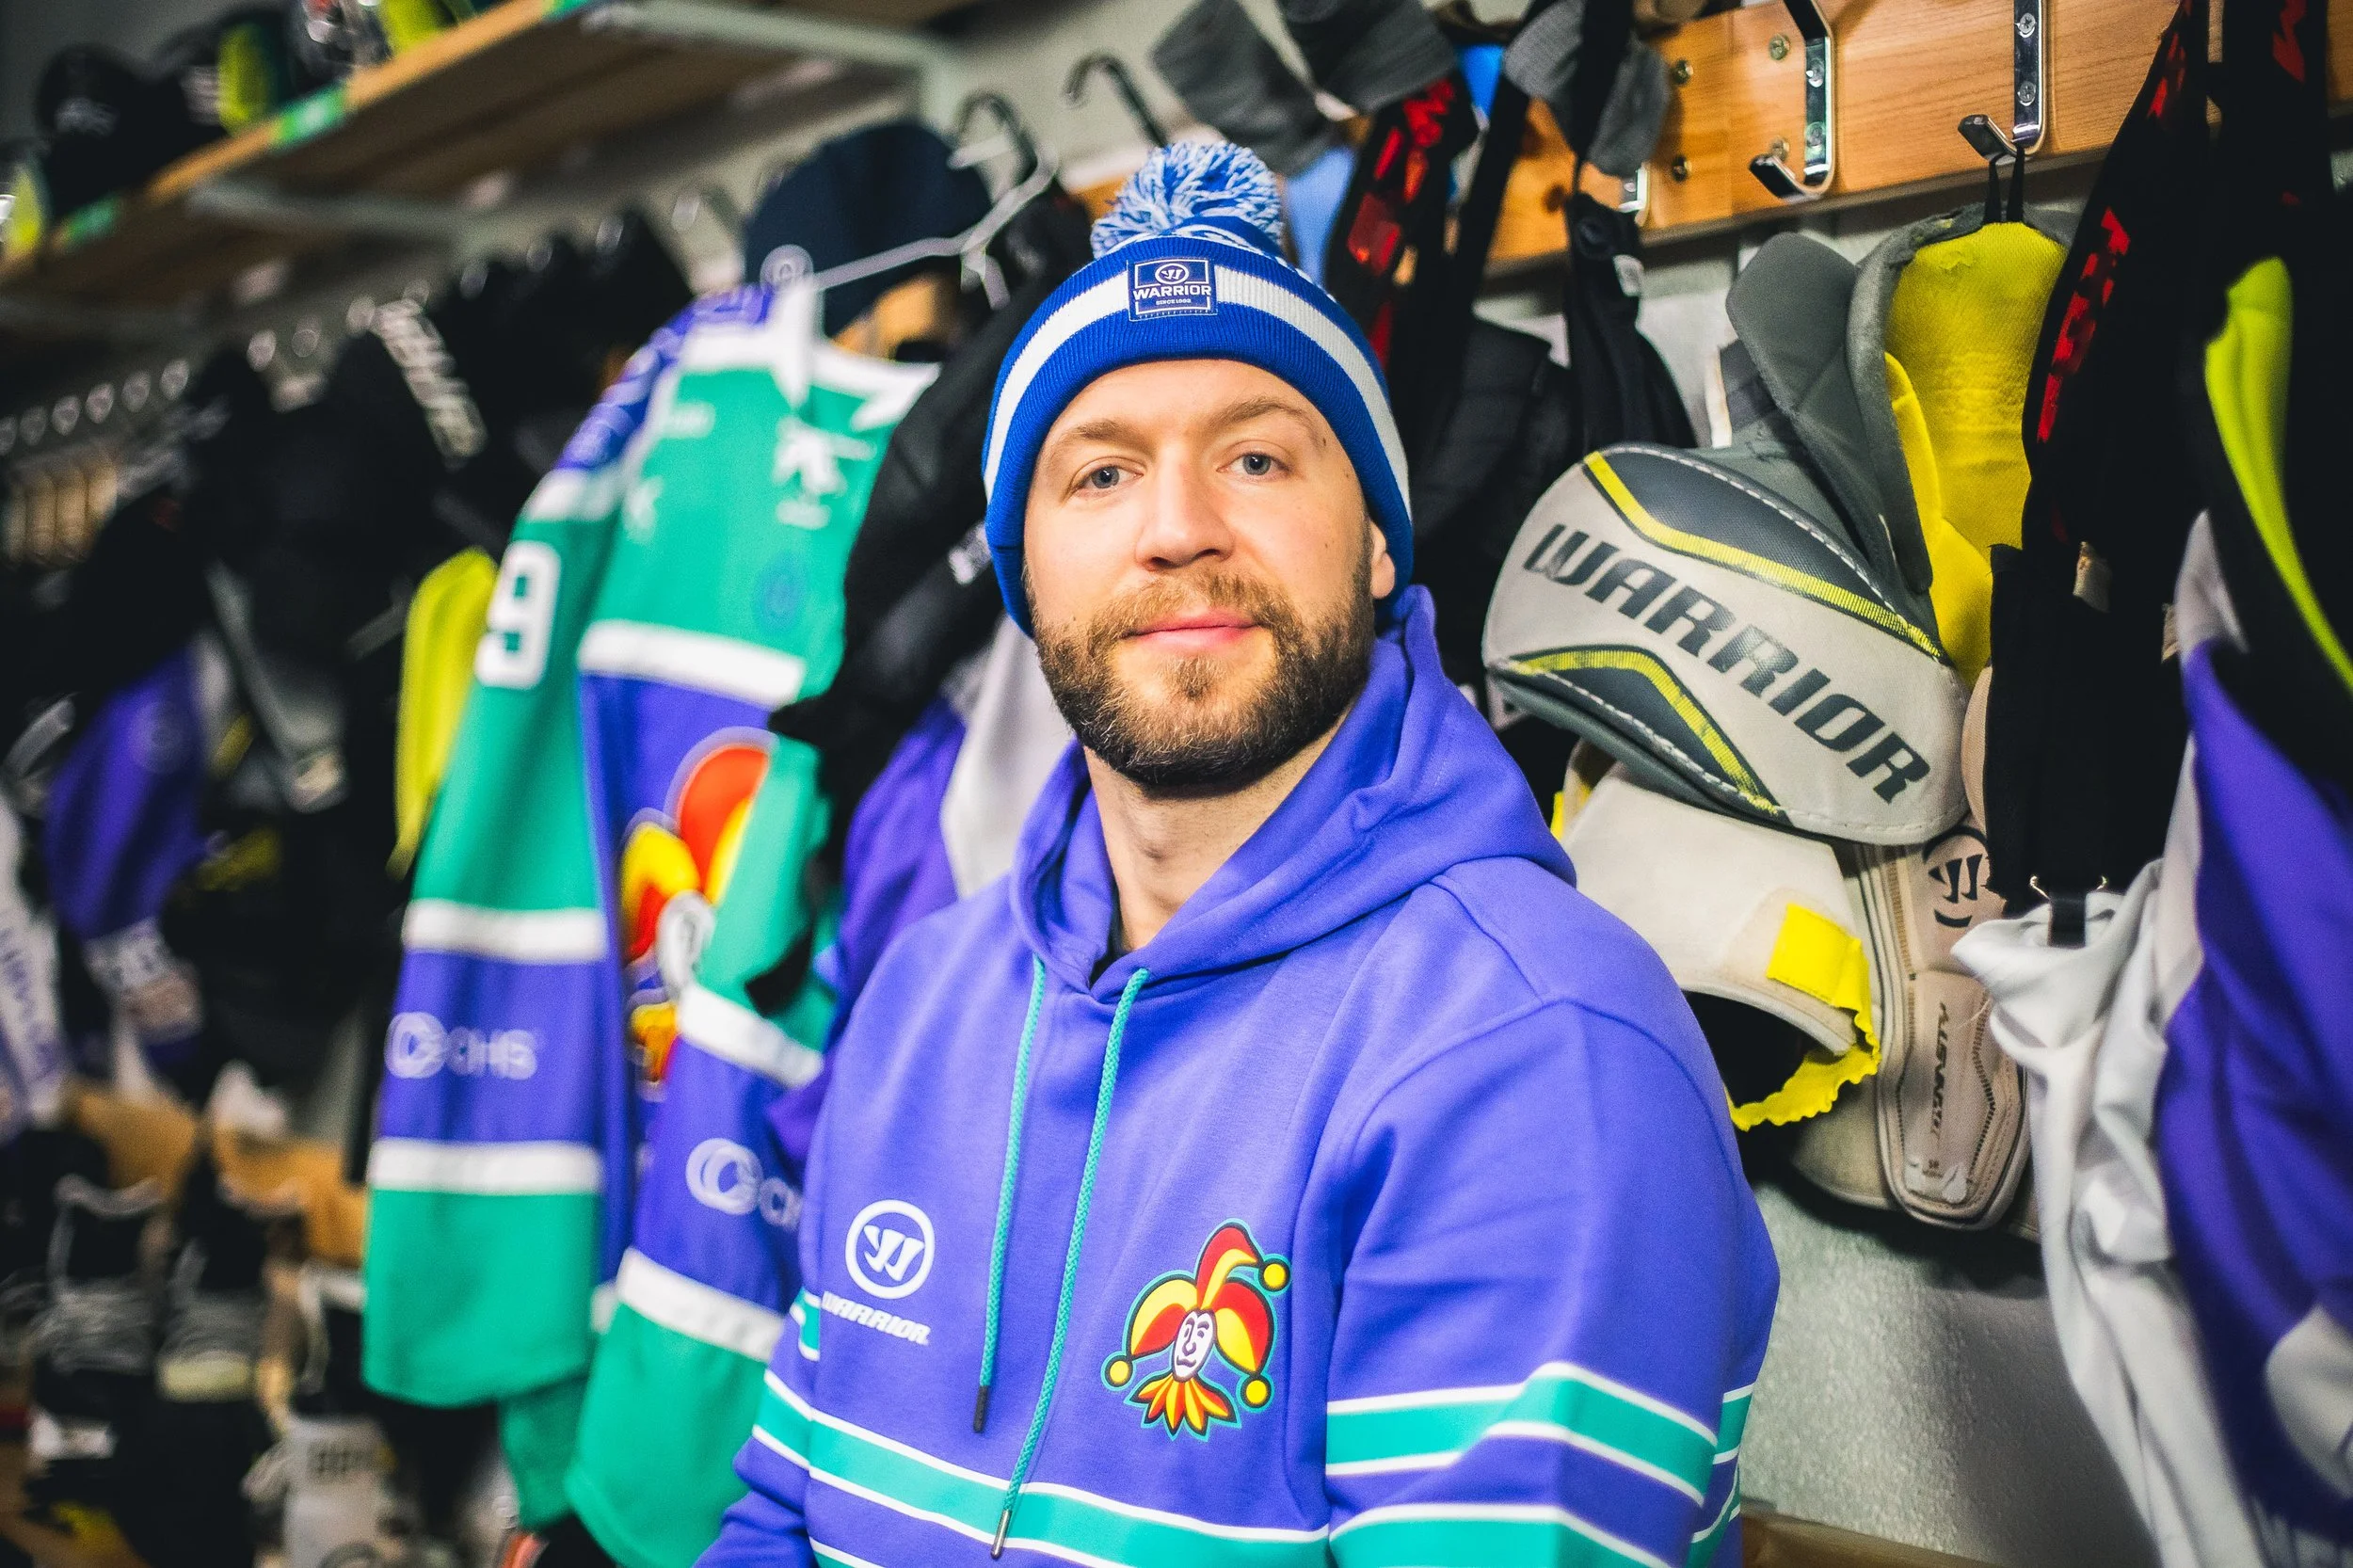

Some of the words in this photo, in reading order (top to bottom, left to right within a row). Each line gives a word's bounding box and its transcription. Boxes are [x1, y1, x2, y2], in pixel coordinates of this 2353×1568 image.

[1132, 284, 1212, 300] WARRIOR
[1523, 522, 1931, 805] WARRIOR
[821, 1289, 932, 1346] WARRIOR
